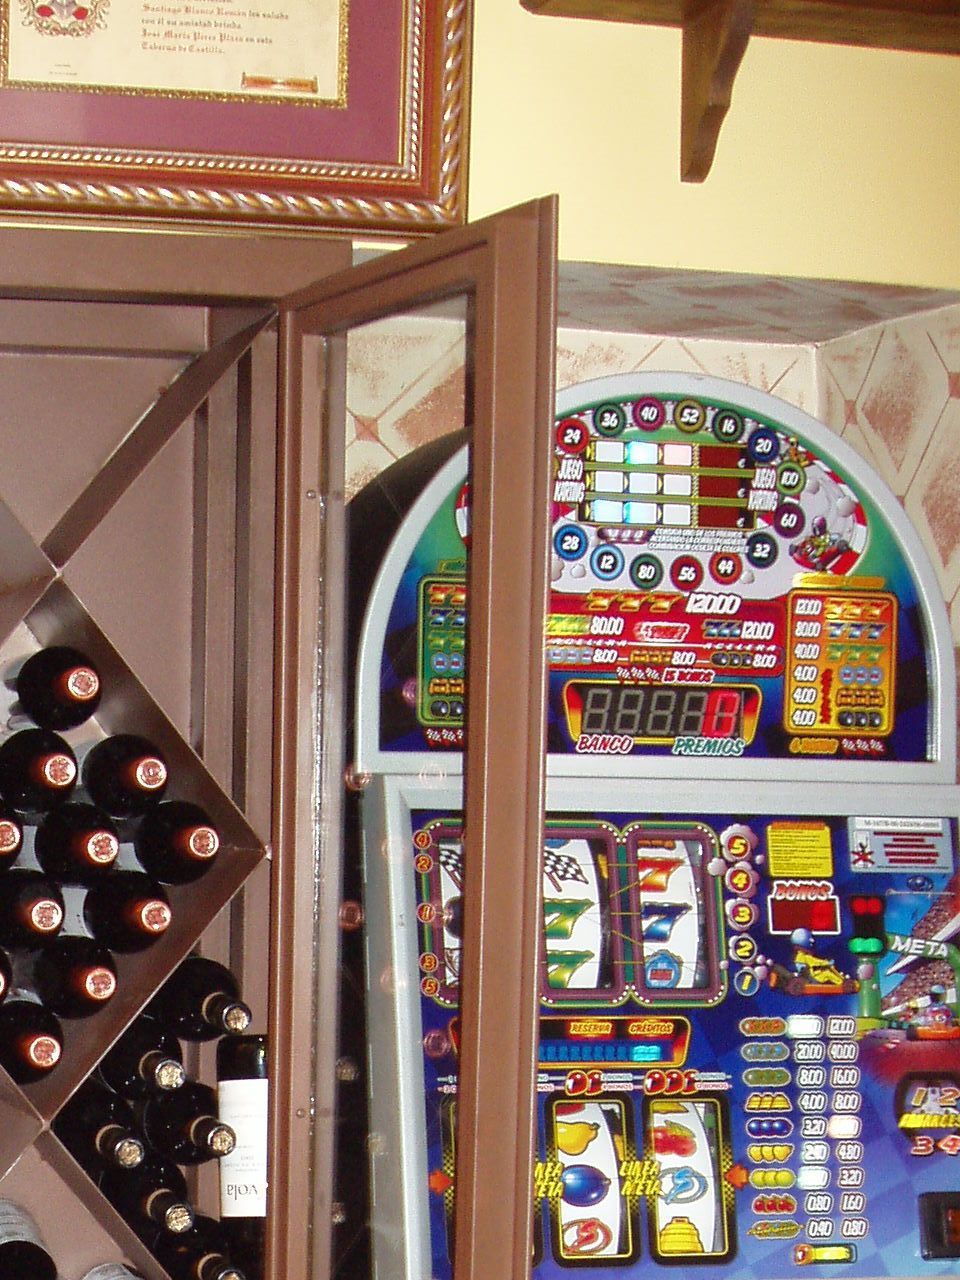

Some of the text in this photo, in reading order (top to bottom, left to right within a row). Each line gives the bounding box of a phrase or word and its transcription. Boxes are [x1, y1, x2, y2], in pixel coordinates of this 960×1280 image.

[601, 413, 619, 427] 36
[641, 407, 658, 421] 40
[681, 410, 700, 424] 52
[722, 418, 736, 433] 16
[563, 429, 582, 443] 24
[755, 438, 772, 453] 20
[558, 459, 583, 480] JUEGO
[752, 468, 777, 489] JUEGO
[780, 472, 800, 487] 100
[780, 513, 798, 528] 60
[563, 536, 581, 550] 28
[753, 544, 771, 558] 32
[600, 555, 615, 570] 12
[716, 560, 734, 575] 44
[637, 565, 656, 580] 80
[678, 567, 696, 582] 56
[576, 734, 634, 754] BANCO
[672, 736, 745, 756] PREMIOS
[729, 837, 746, 853] 5
[731, 872, 748, 888] 4
[774, 882, 833, 901] BONOS
[734, 906, 751, 921] 3
[736, 941, 753, 957] 2
[890, 936, 949, 957] META
[741, 974, 752, 991] 1
[569, 1021, 613, 1035] RESERVA
[911, 1086, 960, 1107] 1 2
[910, 1134, 960, 1156] 3 4
[620, 1160, 660, 1177] LINEA
[621, 1179, 661, 1196] META
